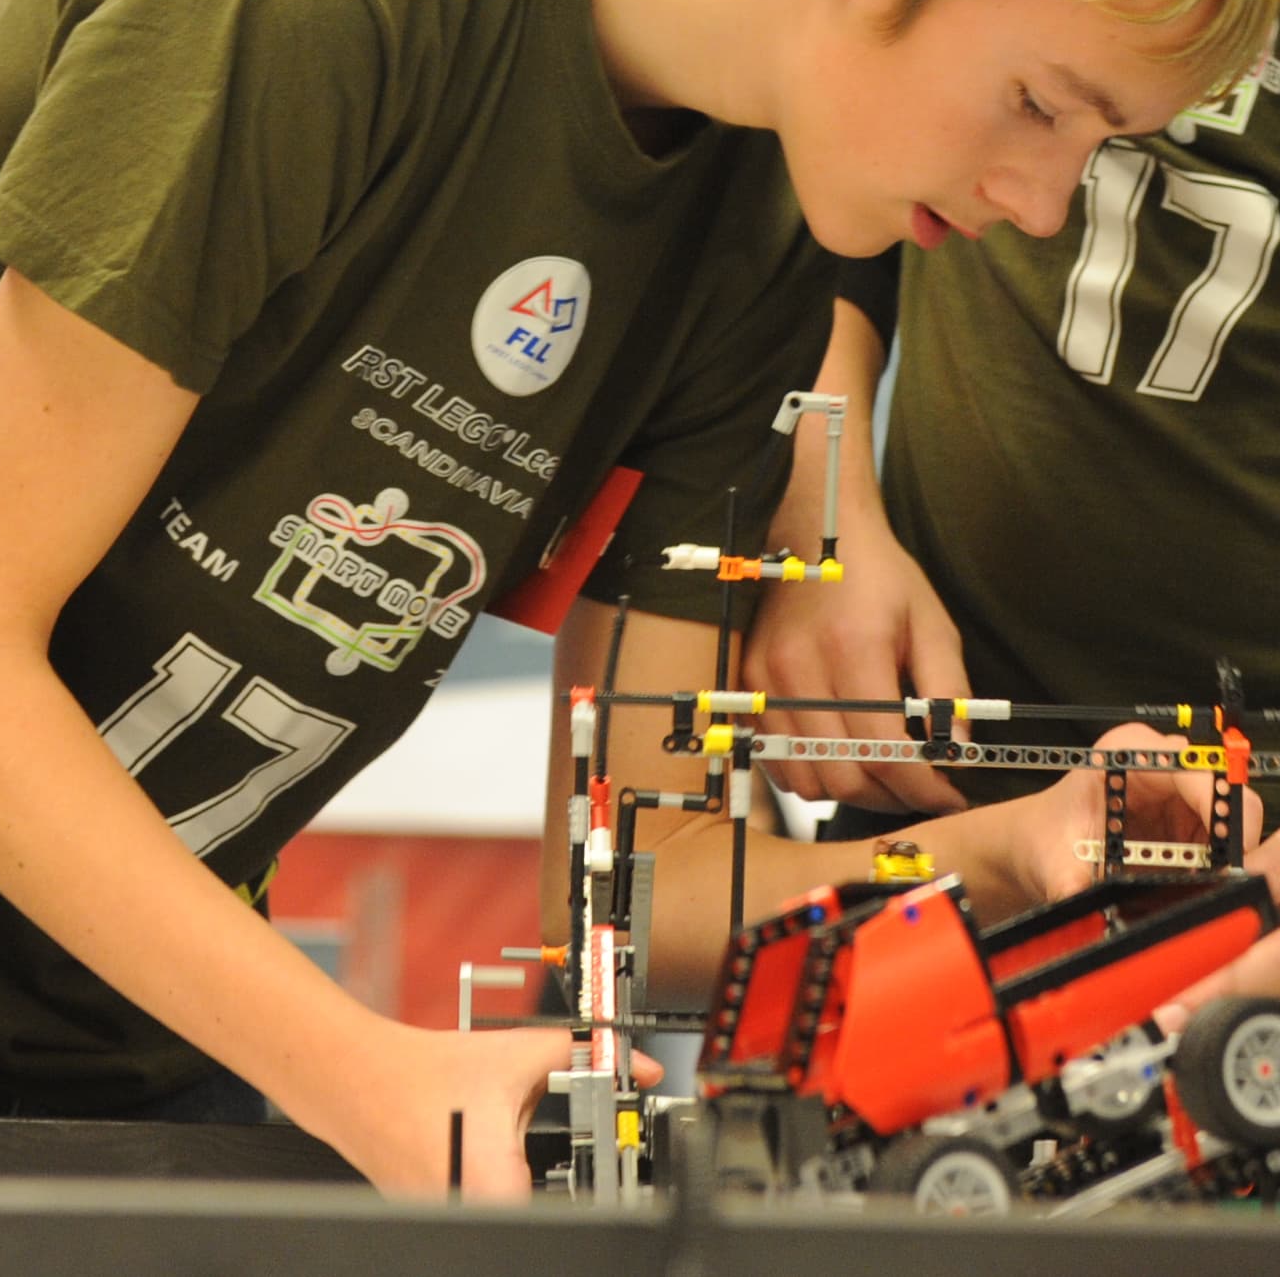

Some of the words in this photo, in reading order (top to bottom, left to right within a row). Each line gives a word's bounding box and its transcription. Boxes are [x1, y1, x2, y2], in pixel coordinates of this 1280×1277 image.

[505, 326, 551, 364] FLL
[159, 497, 240, 582] TEAM
[269, 513, 389, 597] SMART
[376, 578, 470, 639] MOE
[97, 632, 357, 859] 17
